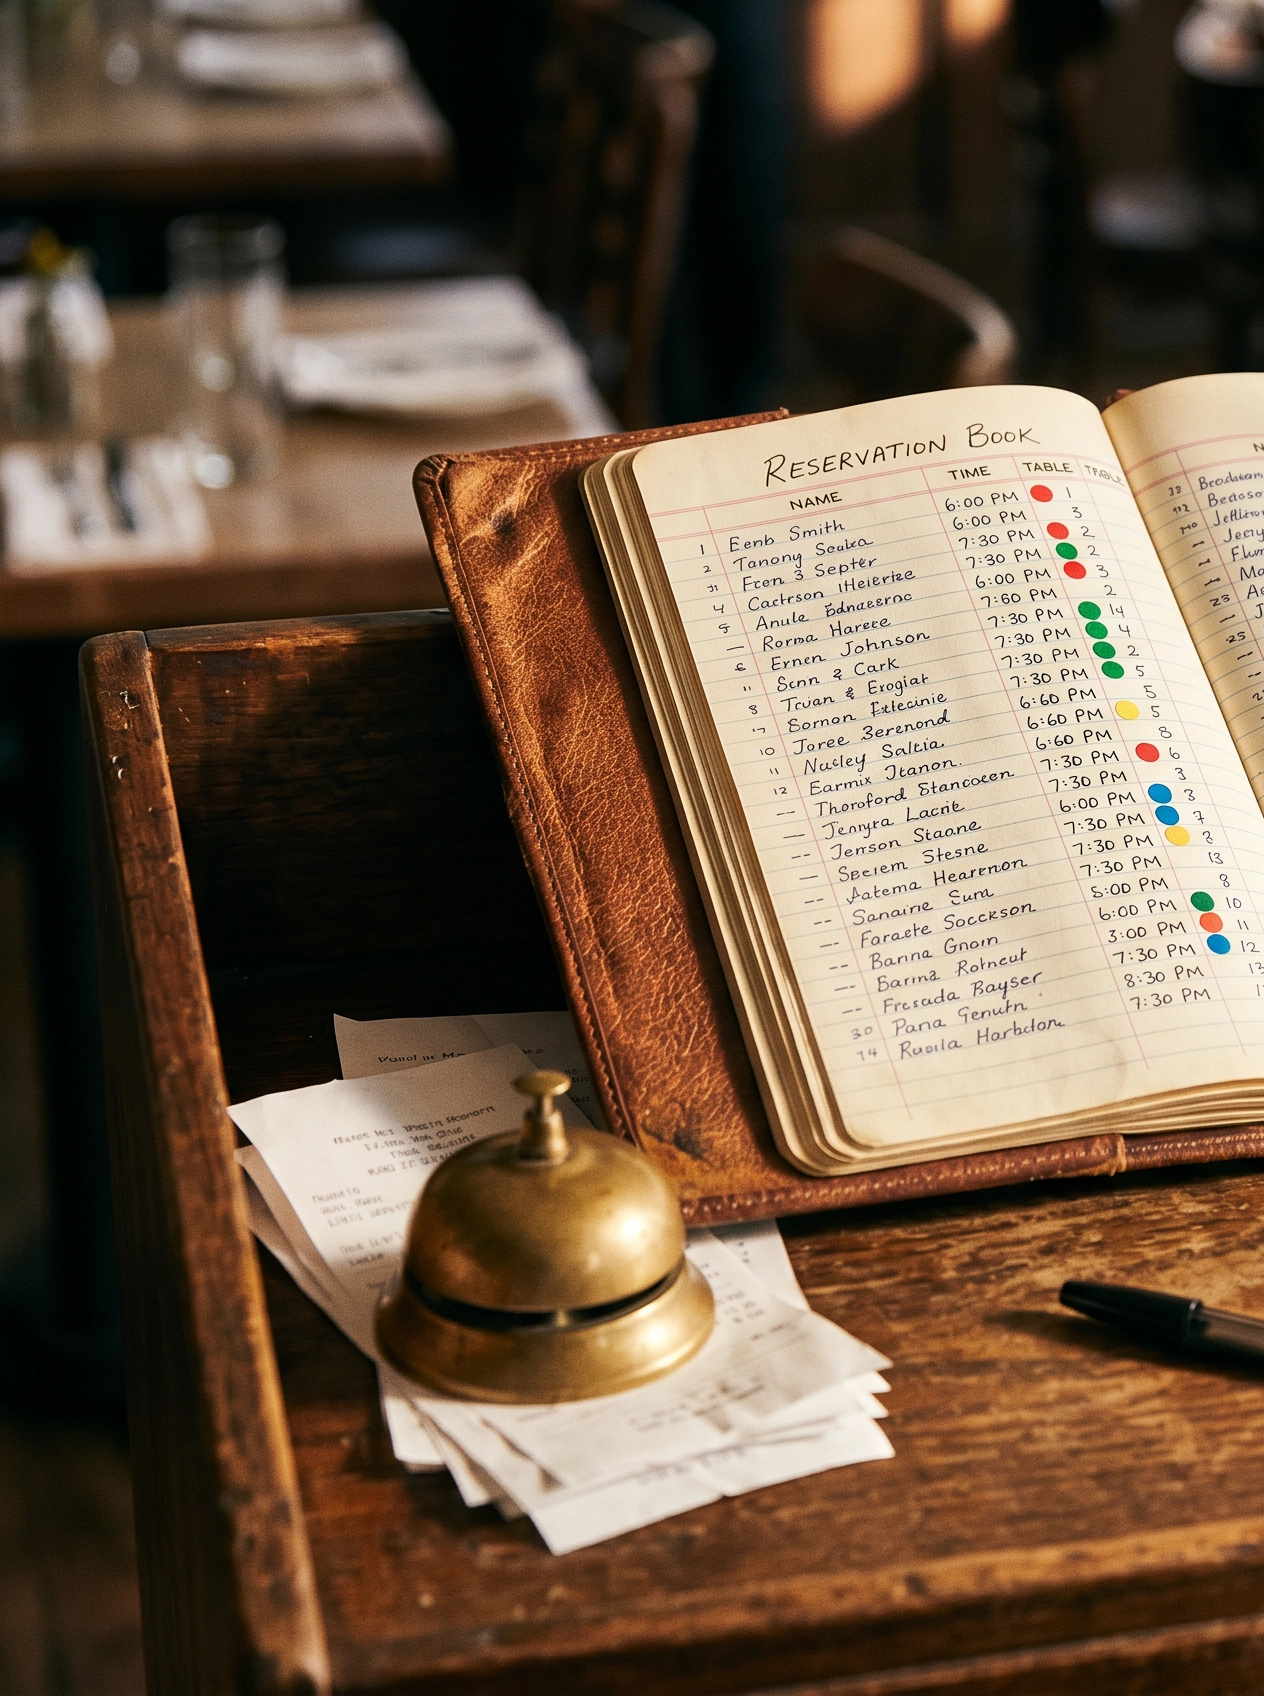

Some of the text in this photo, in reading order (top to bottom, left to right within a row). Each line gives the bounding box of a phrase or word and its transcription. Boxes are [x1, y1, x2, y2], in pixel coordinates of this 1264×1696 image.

[948, 466, 991, 480] TIME
[1022, 463, 1073, 472] TABLE
[790, 492, 842, 510] NAME
[945, 492, 1018, 511] 6:00 PM
[1072, 507, 1082, 518] 3
[953, 511, 1026, 530] 6:00 PM
[790, 520, 845, 541] Smith
[1081, 526, 1095, 537] 2
[959, 529, 1034, 549] 7:30 PM
[1088, 545, 1099, 556] 2
[966, 549, 1041, 568] 7:30 PM
[1096, 565, 1109, 578] 3
[976, 569, 1051, 588] 6:00 PM
[1030, 588, 1057, 601] PM
[1104, 585, 1116, 595] 2
[1109, 604, 1124, 617] 14
[988, 609, 1063, 627] 7:30 PM
[1119, 625, 1131, 637] 4
[995, 628, 1071, 648] 7:30 PM
[772, 633, 930, 671] Ernen Johnson
[1128, 645, 1139, 656] 2
[1001, 649, 1079, 668] 7:30 PM
[854, 658, 899, 675] Cark
[1136, 665, 1144, 677] 5
[1010, 669, 1088, 687] 7:30 PM
[1068, 688, 1096, 701] PM
[1143, 685, 1156, 698] 5
[1075, 709, 1103, 722] PM
[1151, 706, 1159, 717] 5
[1083, 730, 1112, 743] PM
[1159, 727, 1172, 738] 8
[1169, 747, 1180, 759] 6
[1040, 751, 1119, 770] 7:30 PM
[1175, 768, 1186, 780] 3
[1049, 771, 1127, 792] 7:30 PM
[774, 787, 787, 795] 12
[1184, 789, 1195, 801] 3
[1060, 792, 1136, 812] 6:00 PM
[1064, 813, 1145, 834] 7:30 PM
[1073, 835, 1153, 855] 7:30 PM
[1080, 856, 1161, 876] 7:30 PM
[1139, 878, 1168, 891] PM
[1220, 874, 1230, 887] 8
[1226, 897, 1241, 908] 10
[1099, 899, 1177, 920] 6:00 PM
[1237, 920, 1249, 930] 11
[1109, 922, 1186, 943] 3:00 PM
[1241, 941, 1260, 952] 12
[1113, 944, 1196, 964] 7:30 PM
[1124, 965, 1204, 987] 8:30 PM
[1130, 988, 1210, 1009] 7:30 PM
[892, 1018, 946, 1036] Pana
